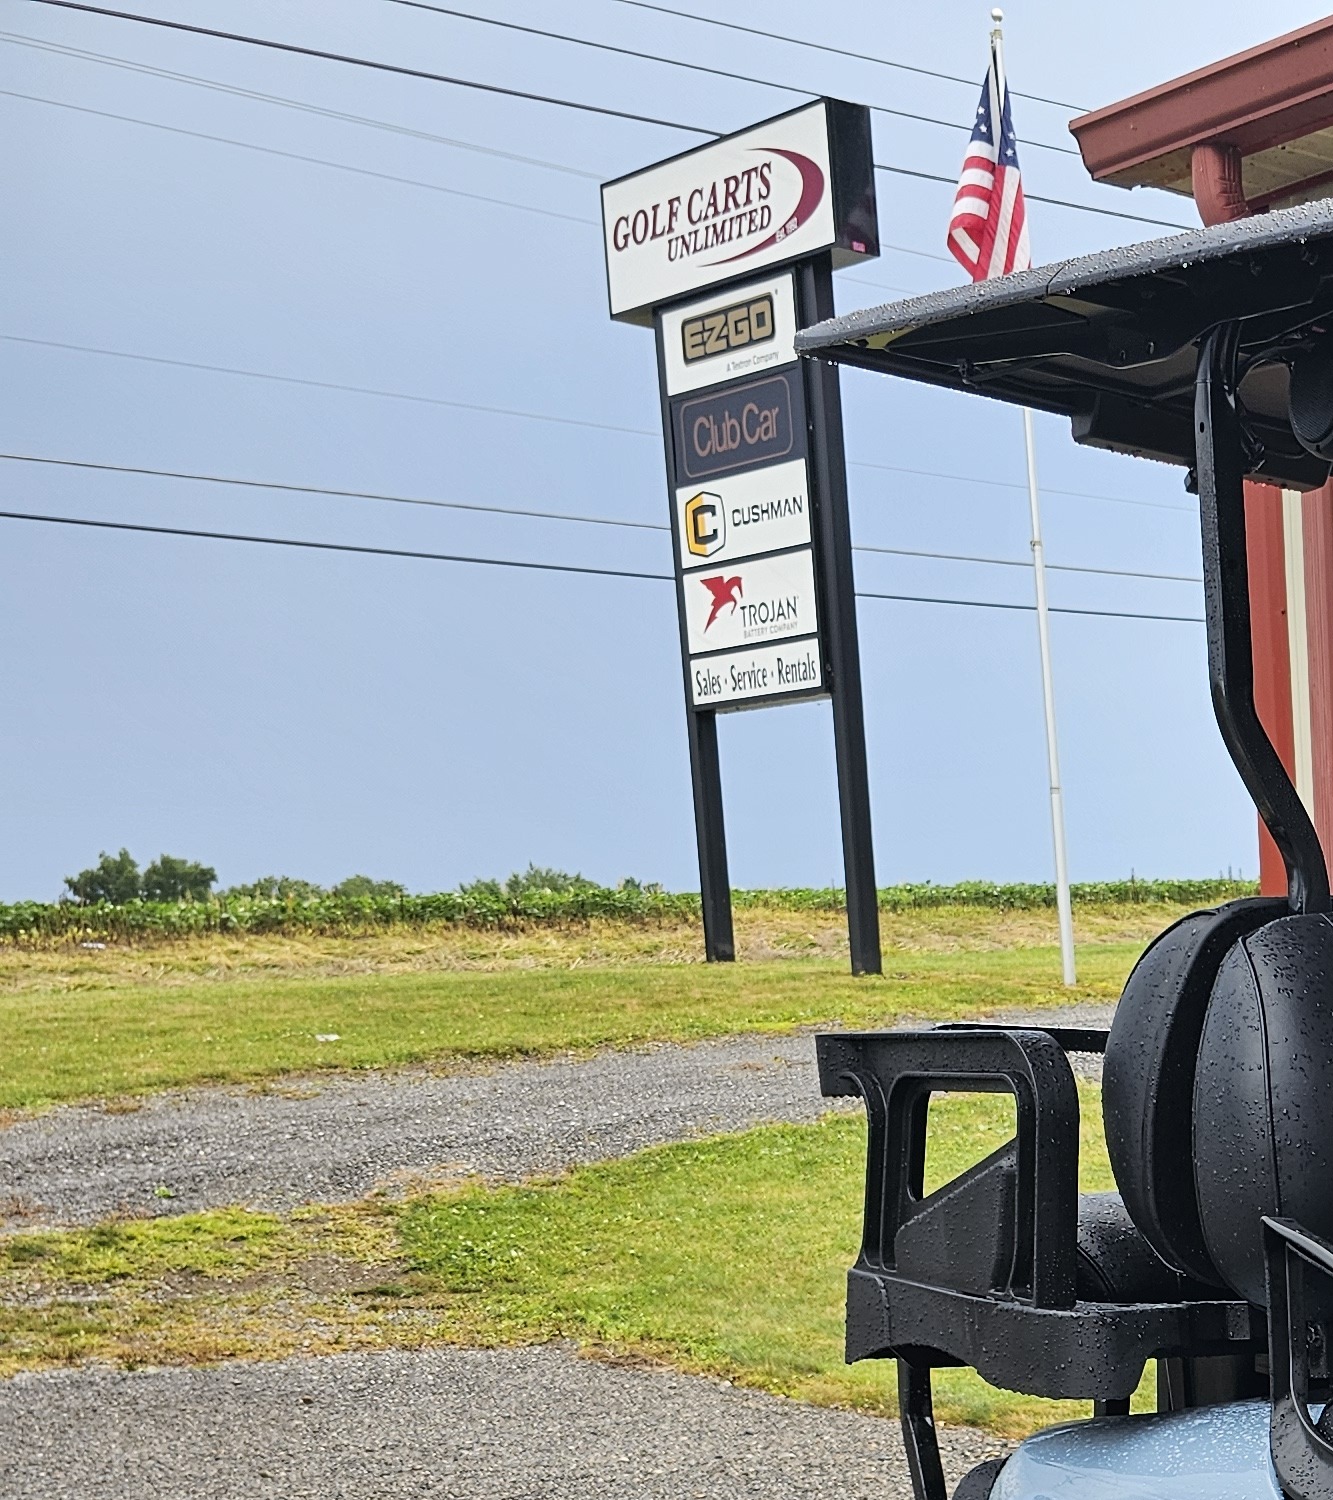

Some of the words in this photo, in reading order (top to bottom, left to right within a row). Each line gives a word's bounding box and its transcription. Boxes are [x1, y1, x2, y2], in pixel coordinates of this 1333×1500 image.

[613, 196, 681, 251] GOLF
[687, 161, 772, 225] CARTS
[667, 204, 772, 262] UNLIMITED
[693, 411, 740, 457] Club
[742, 402, 780, 445] Car
[732, 495, 803, 527] CUSHMAN
[740, 595, 797, 627] TROJAN
[744, 627, 768, 639] BATTERY
[695, 669, 722, 697] Sales
[730, 661, 767, 692] Service
[777, 652, 816, 685] Rentals
